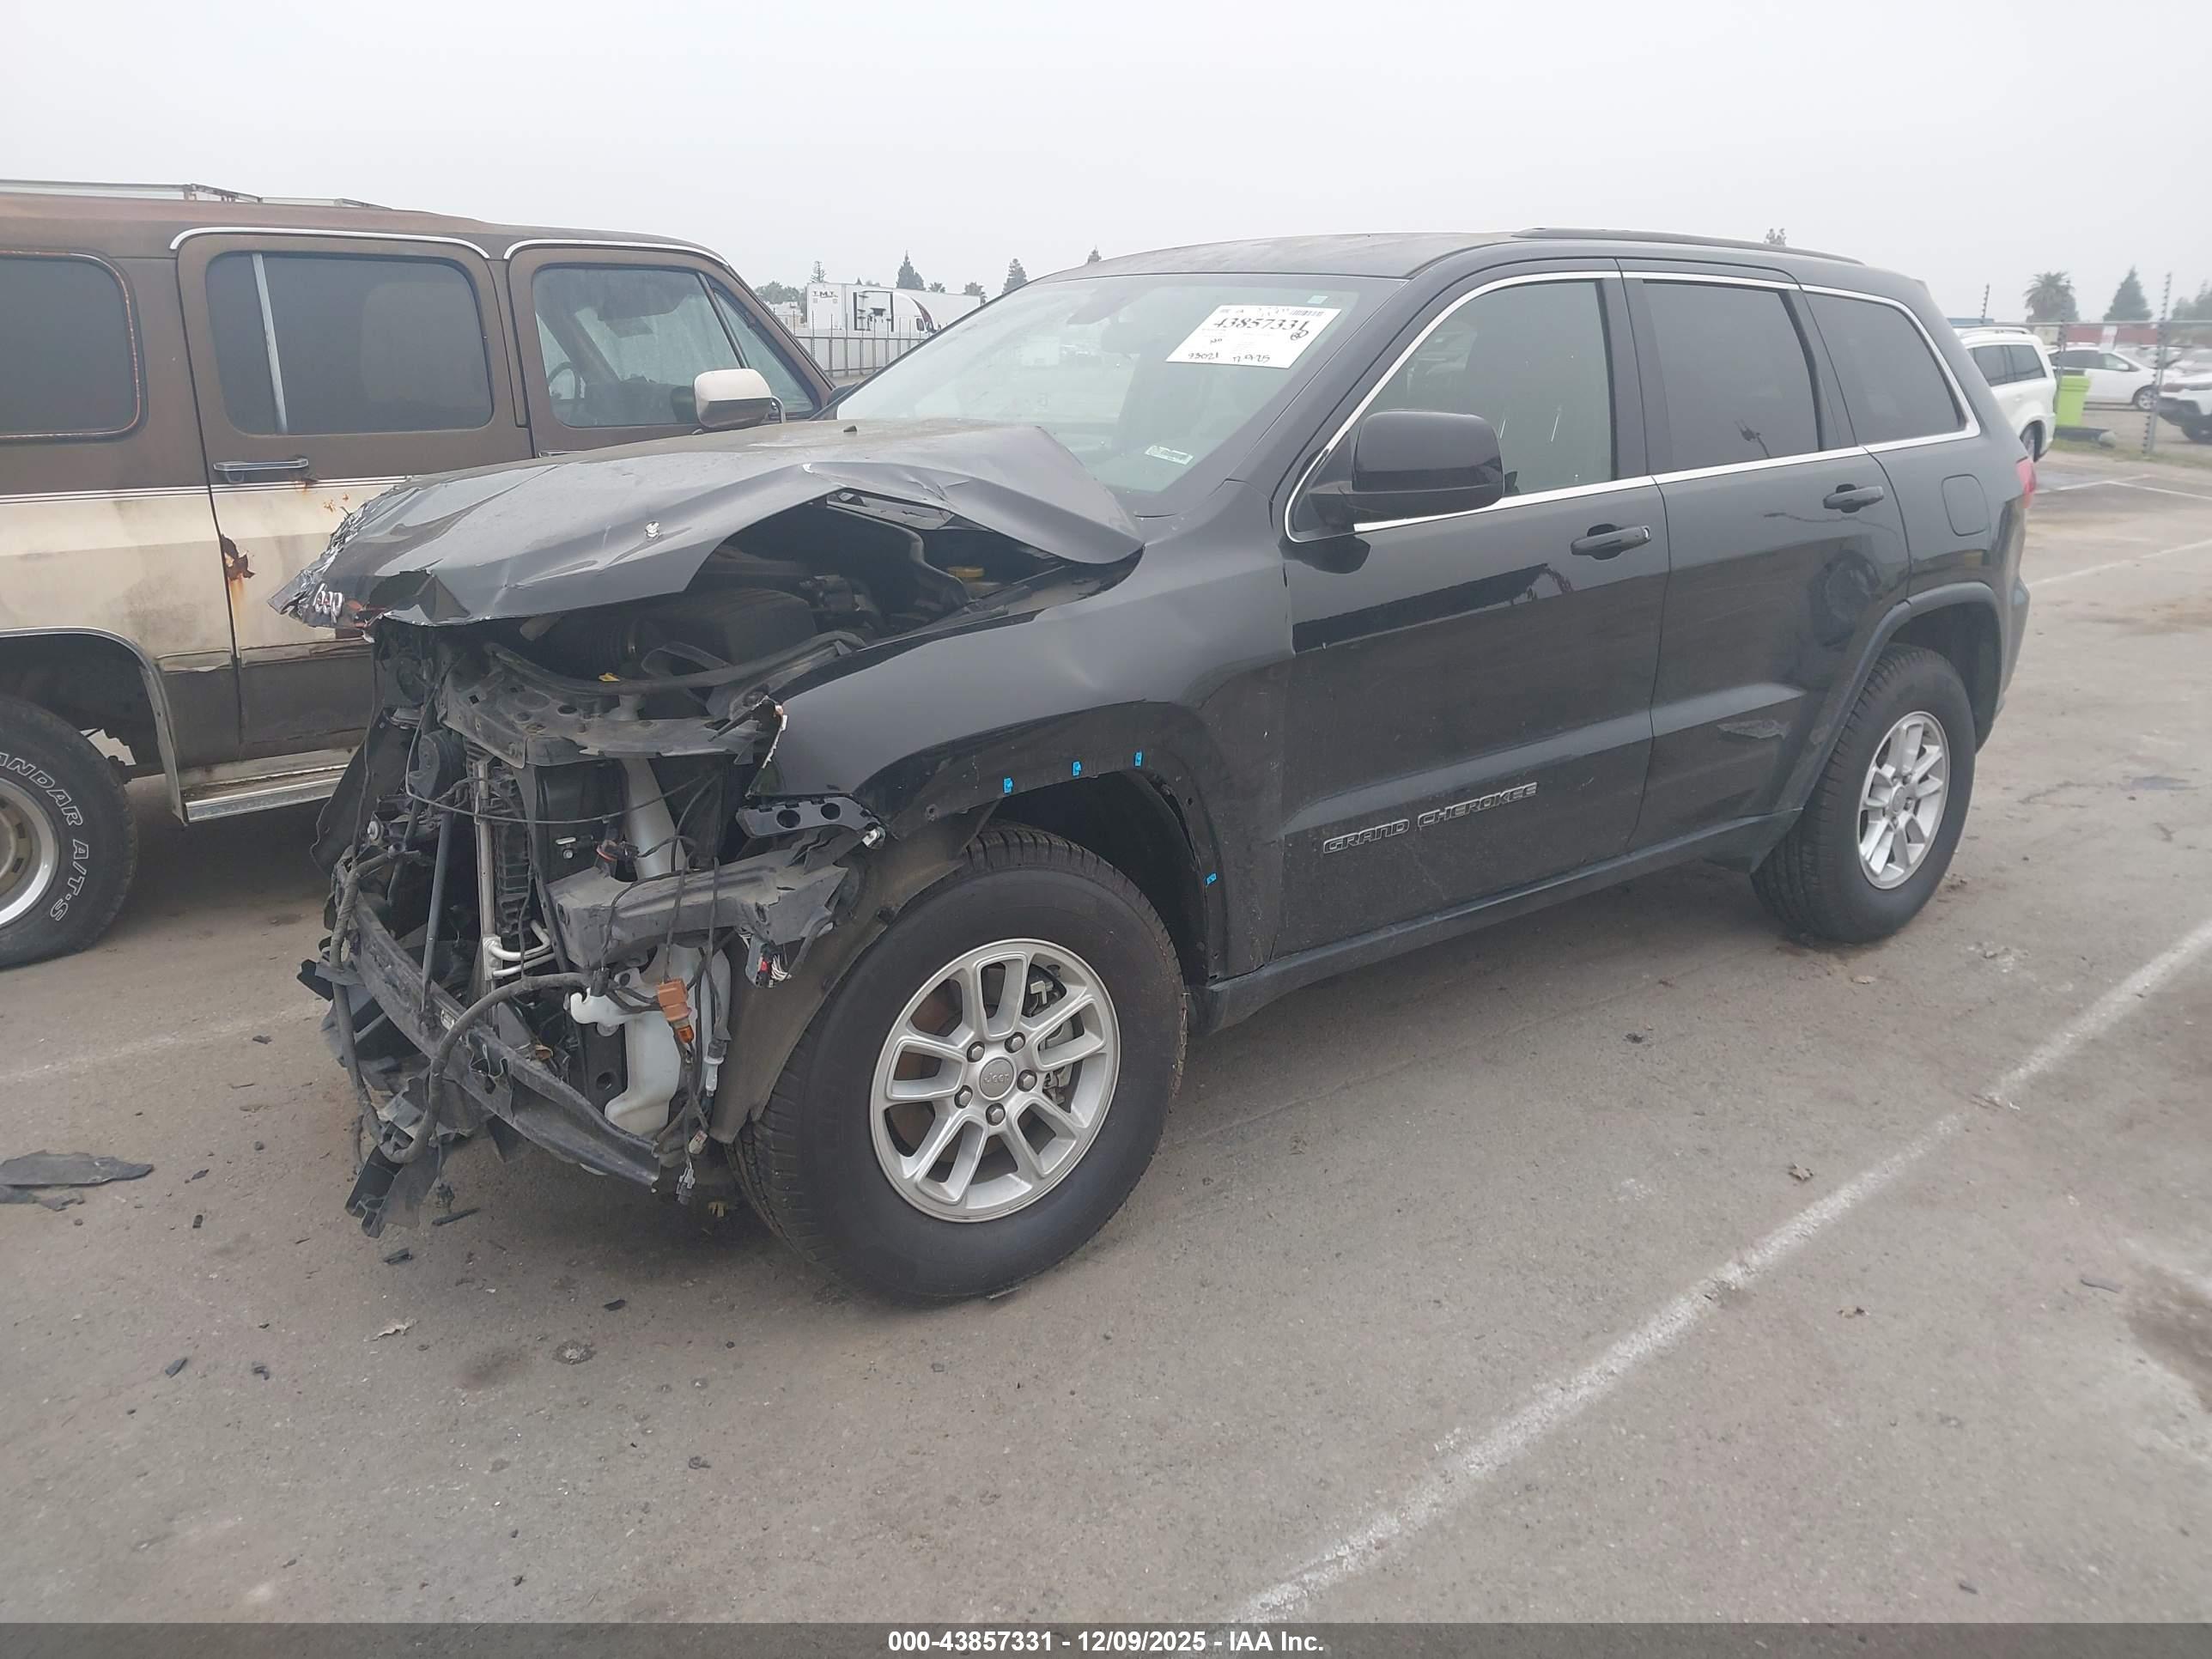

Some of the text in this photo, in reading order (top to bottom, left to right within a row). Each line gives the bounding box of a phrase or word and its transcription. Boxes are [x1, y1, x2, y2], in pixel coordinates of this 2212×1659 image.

[1213, 316, 1310, 331] 43857331
[1322, 781, 1538, 854] GRAND CHEROKEE
